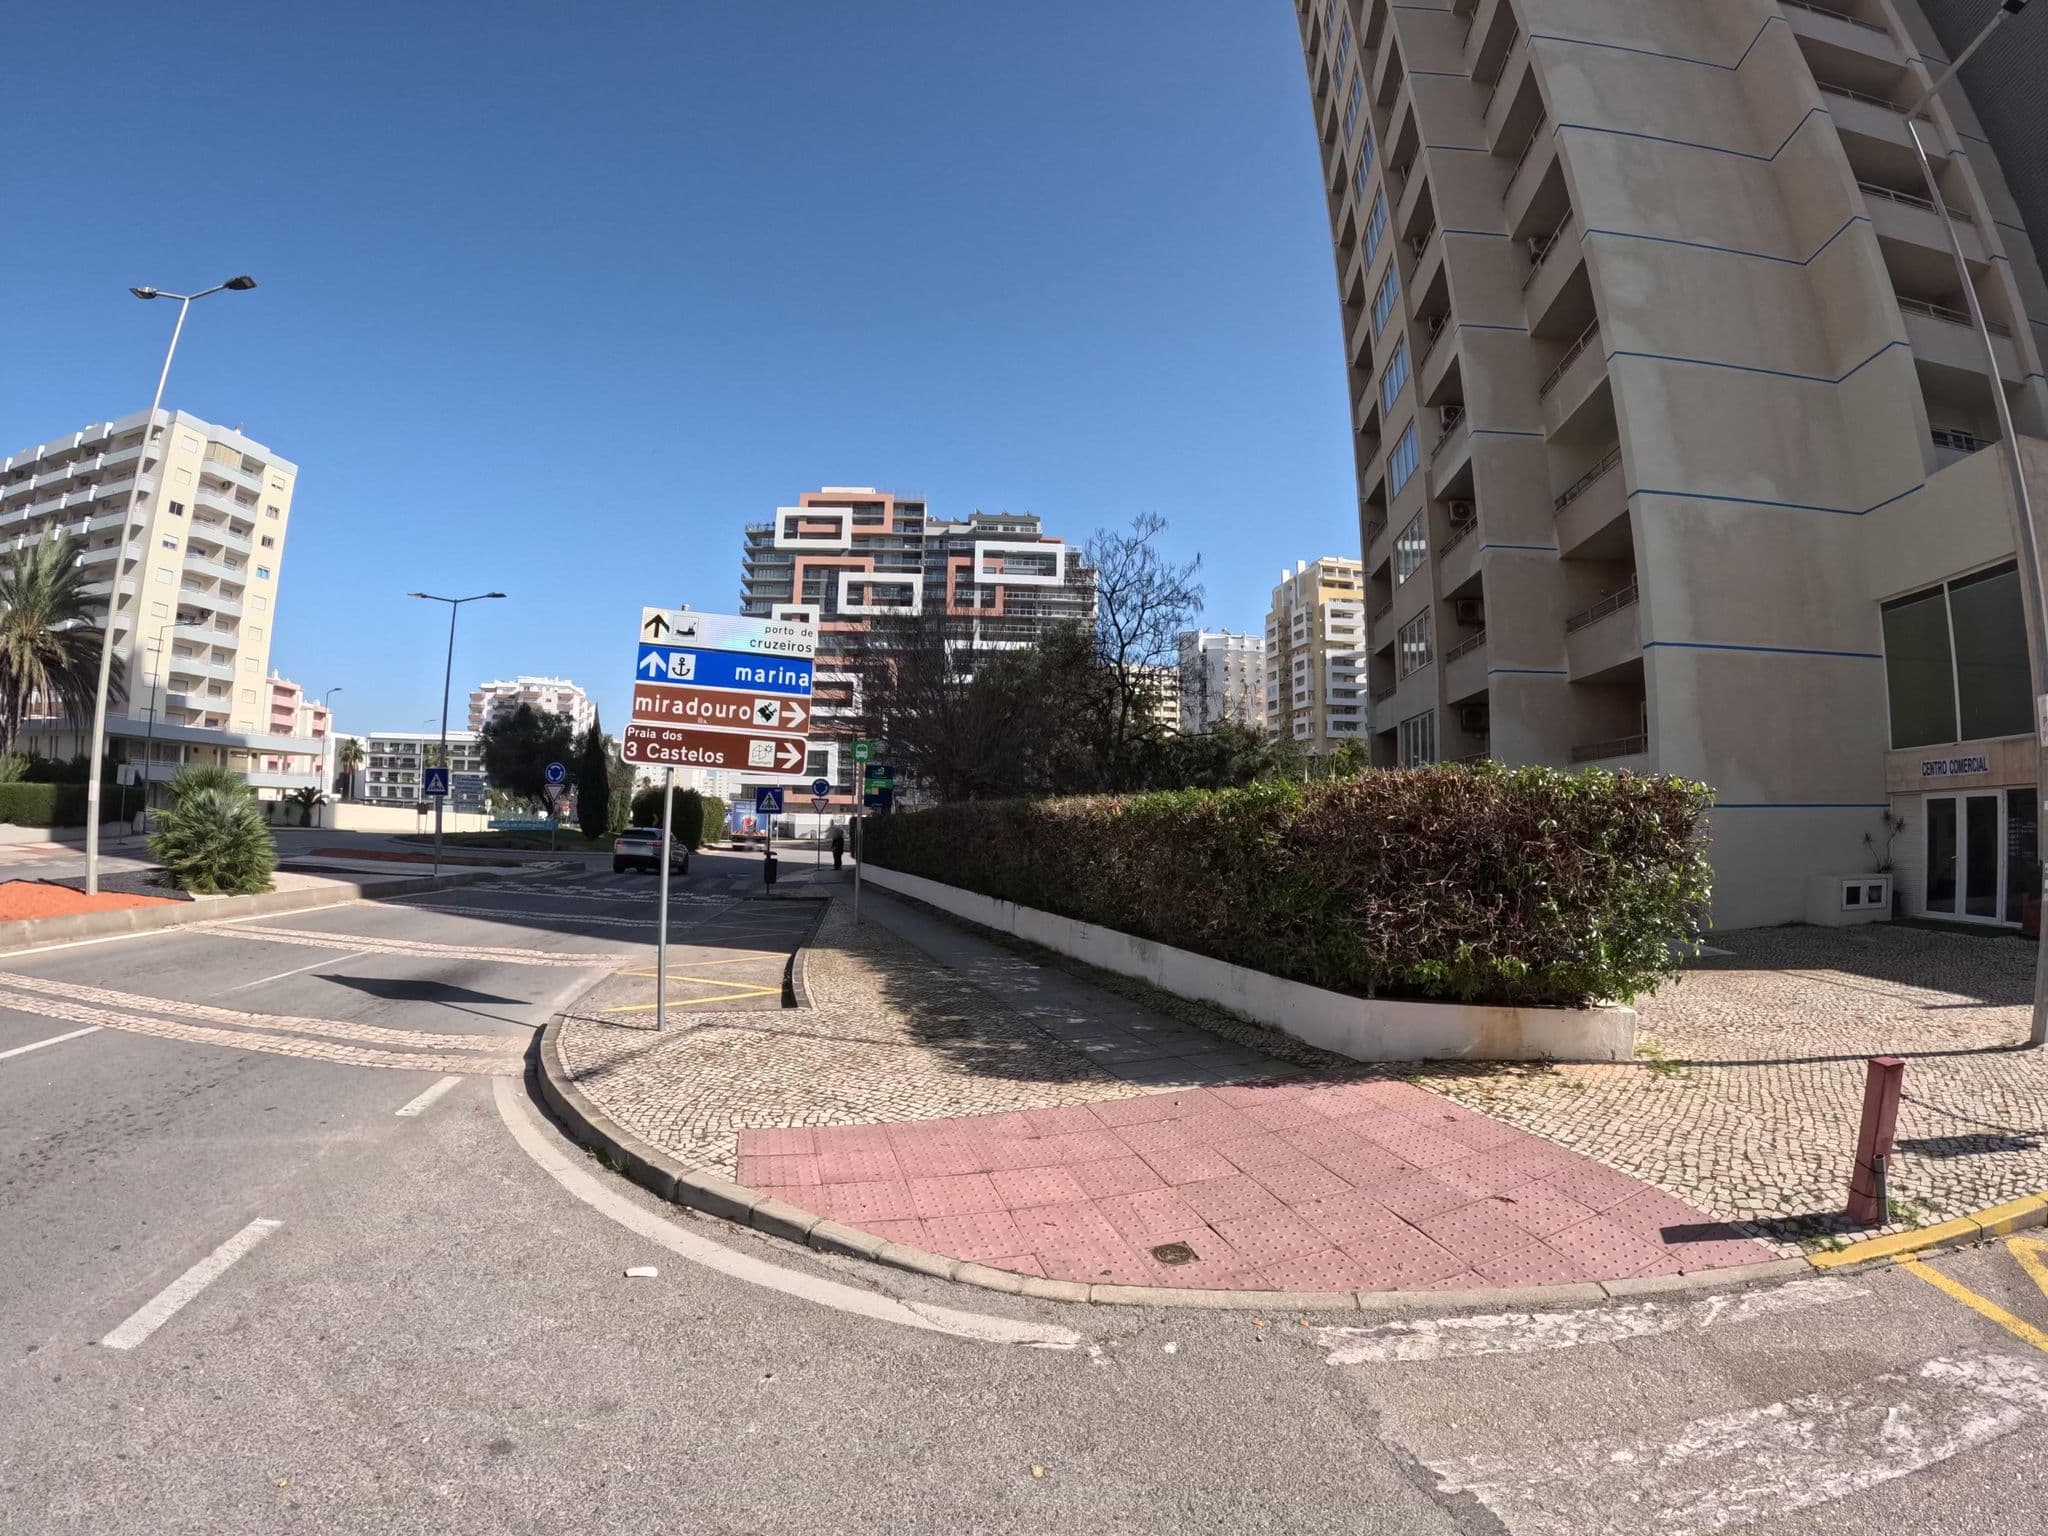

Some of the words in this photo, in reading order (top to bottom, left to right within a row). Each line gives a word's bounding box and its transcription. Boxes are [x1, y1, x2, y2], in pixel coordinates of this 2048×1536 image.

[765, 626, 795, 636] porto
[801, 627, 814, 637] de
[750, 638, 812, 653] cruzeiros
[735, 666, 810, 687] marina
[635, 694, 751, 720] miradouro
[627, 727, 657, 739] Praia
[662, 730, 683, 741] dos
[626, 741, 638, 757] 3
[646, 743, 724, 764] Castelos
[1921, 761, 1948, 776] CENTRO
[1948, 757, 1988, 775] COMERCIAL
